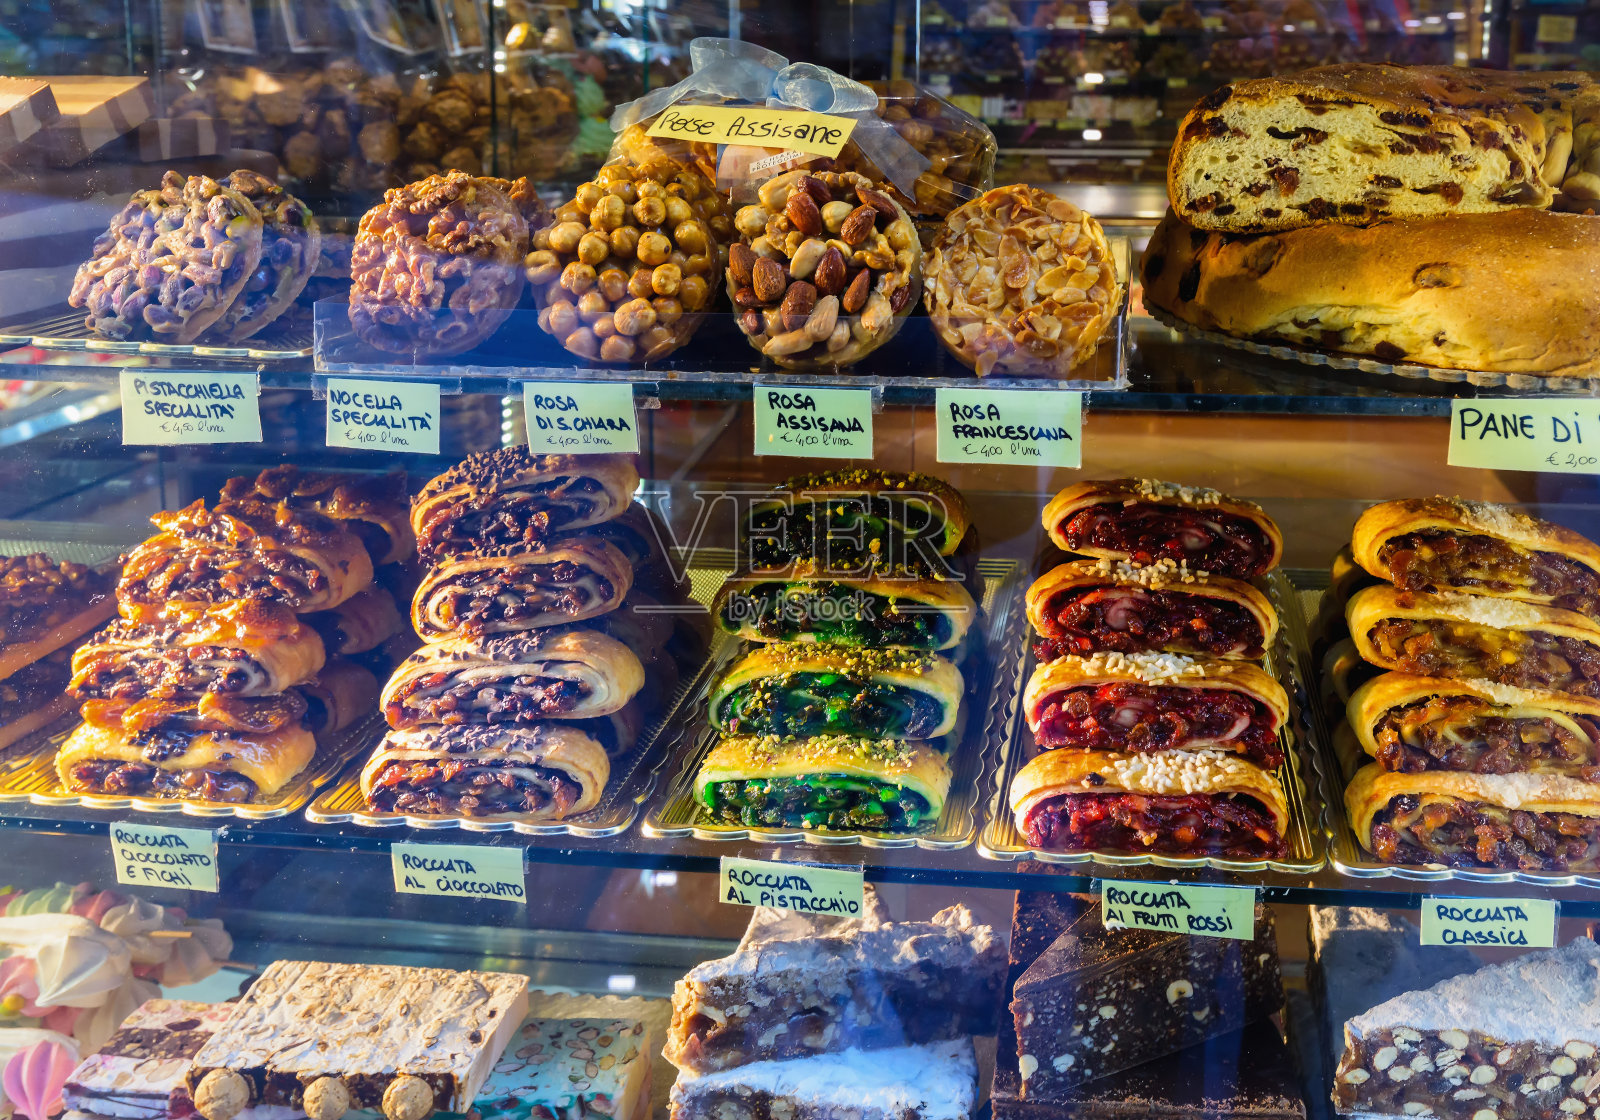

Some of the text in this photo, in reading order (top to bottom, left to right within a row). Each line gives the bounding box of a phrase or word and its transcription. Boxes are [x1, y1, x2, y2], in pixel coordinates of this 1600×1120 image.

[726, 116, 843, 145] Assisane
[329, 389, 403, 411] NOCELLA
[533, 394, 579, 412] ROSA
[767, 391, 817, 412] ROSA
[949, 402, 1001, 423] ROSA
[776, 415, 866, 434] ASSISANA
[952, 423, 1073, 442] FRANCESCANA
[1459, 407, 1536, 441] PANE
[980, 444, 1003, 458] 4,00
[1565, 453, 1598, 468] 2,00
[126, 865, 136, 879] E
[402, 853, 477, 874] ROCCIATA
[404, 875, 426, 889] AL
[728, 869, 813, 893] ROCCIATA
[727, 886, 751, 904] AL
[1106, 887, 1191, 910] ROCCIATA
[1105, 908, 1125, 923] AI
[1436, 905, 1529, 923] ROCCIATA
